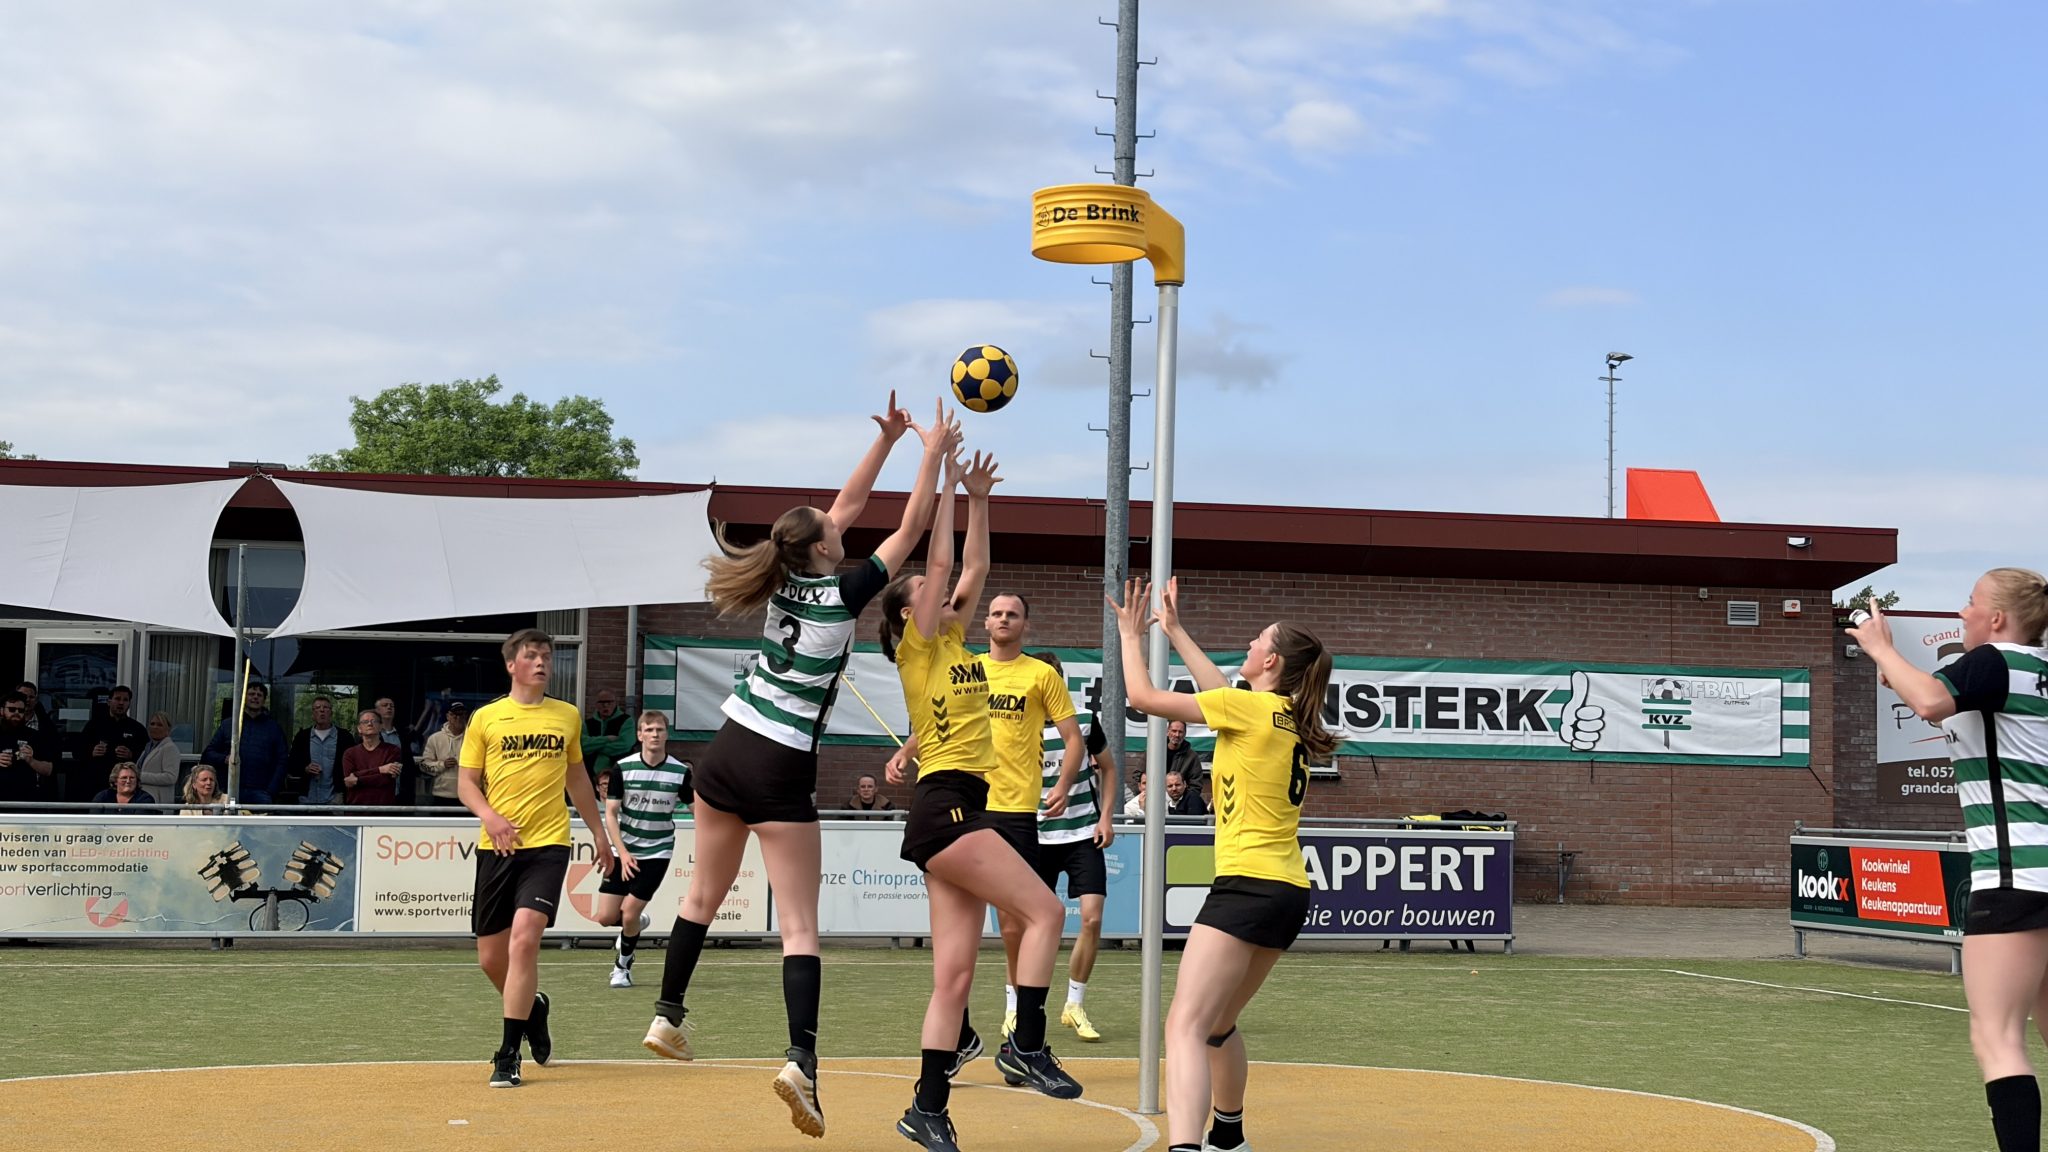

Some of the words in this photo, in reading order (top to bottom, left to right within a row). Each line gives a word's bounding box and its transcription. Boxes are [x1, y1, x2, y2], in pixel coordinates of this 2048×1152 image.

[1053, 207, 1078, 223] De
[1087, 203, 1139, 222] Brink
[767, 614, 802, 675] 3
[1922, 627, 1961, 646] Grand
[1649, 714, 1684, 725] KVZ
[1288, 741, 1310, 807] 6
[950, 807, 964, 823] 11
[54, 834, 62, 843] u
[66, 834, 102, 845] graag
[106, 834, 135, 843] over
[138, 833, 154, 843] de
[44, 849, 67, 858] van
[21, 862, 149, 874] sportaccommodatie
[1861, 858, 1911, 875] Kookwinkel
[1798, 868, 1850, 902] kookx
[1861, 877, 1897, 893] Keukens
[863, 891, 877, 900] Een
[878, 892, 902, 901] passie
[903, 892, 921, 900] voor
[1861, 896, 1943, 916] Keukenapparatuur
[1340, 908, 1395, 927] voor
[1401, 903, 1496, 927] bouwen
